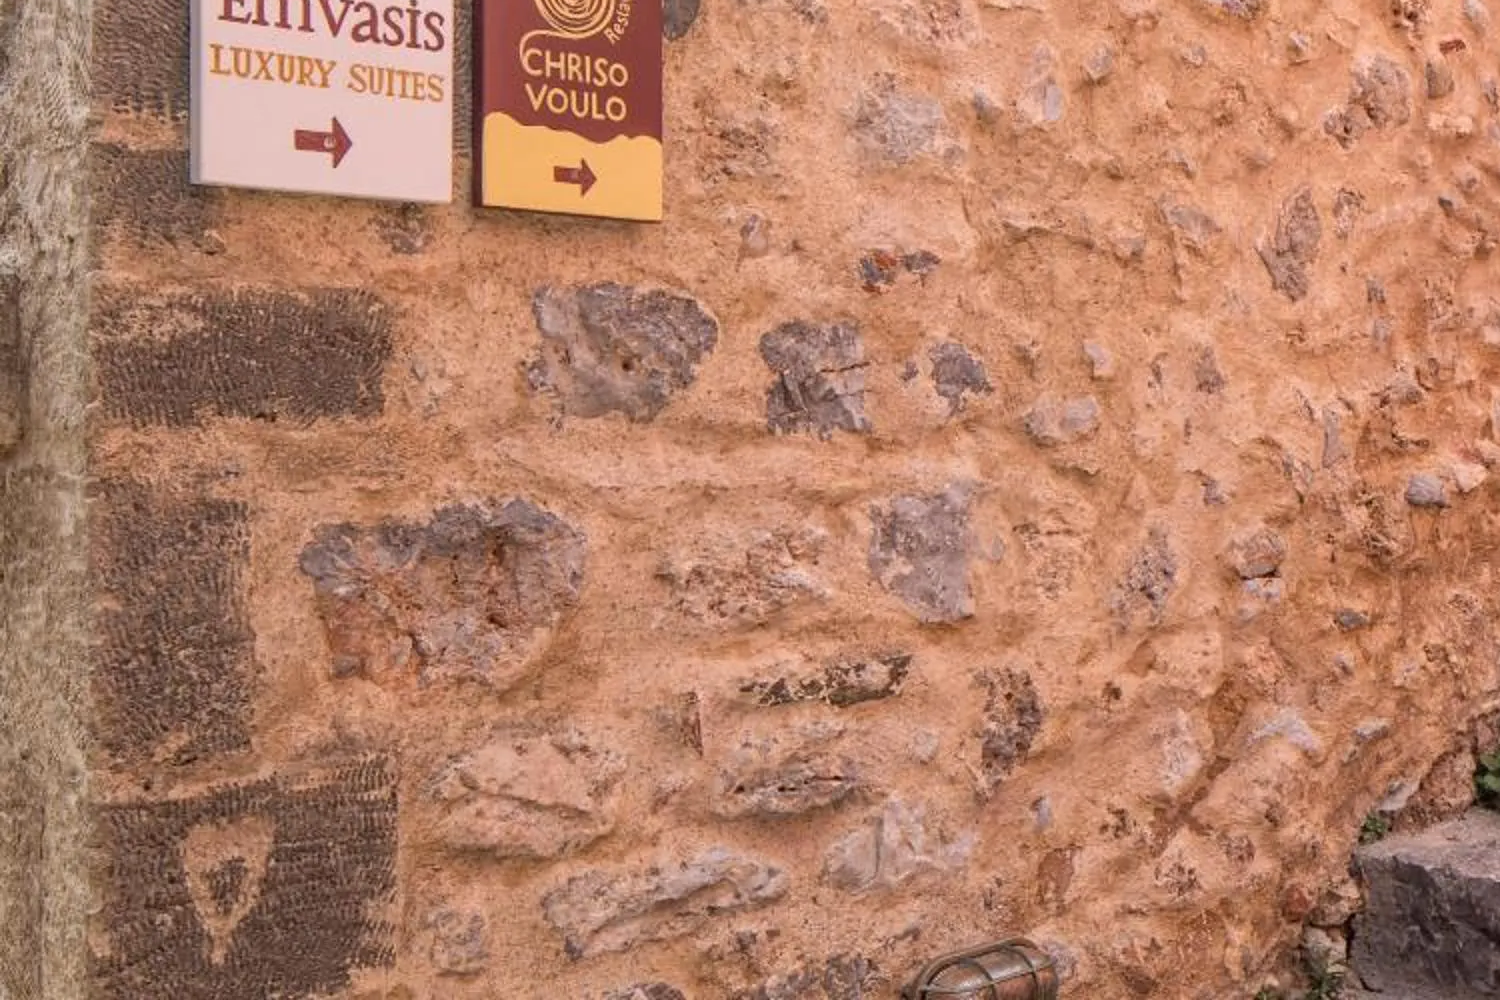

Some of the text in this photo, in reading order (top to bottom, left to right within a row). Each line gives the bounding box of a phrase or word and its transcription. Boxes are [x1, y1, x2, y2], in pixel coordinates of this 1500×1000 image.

[209, 43, 445, 102] LUXURY SUITES
[521, 47, 629, 87] CHRISO
[524, 83, 627, 121] VOULO
